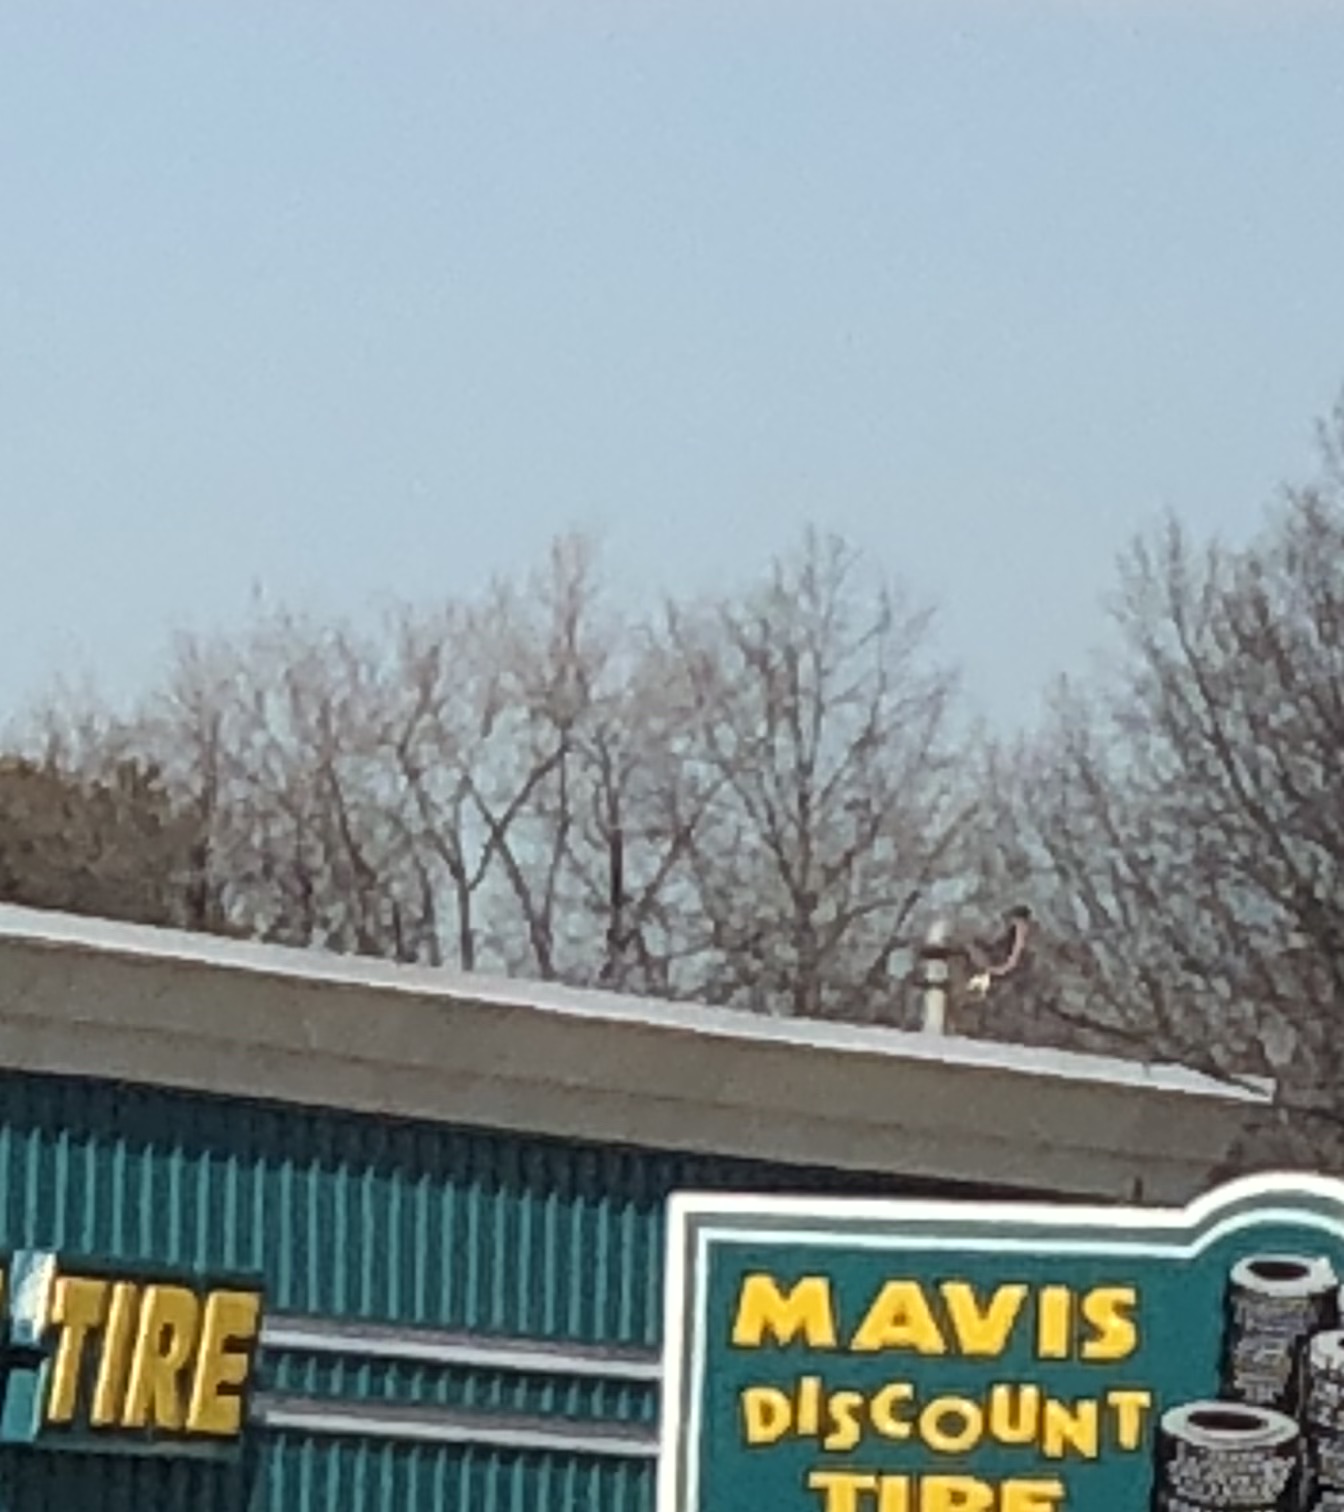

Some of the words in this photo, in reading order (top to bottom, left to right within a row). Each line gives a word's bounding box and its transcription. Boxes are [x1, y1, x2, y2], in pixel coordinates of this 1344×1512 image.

[47, 1275, 262, 1436] TIRE
[731, 1273, 1138, 1359] MAVIS
[741, 1375, 1151, 1460] DISCOUNT
